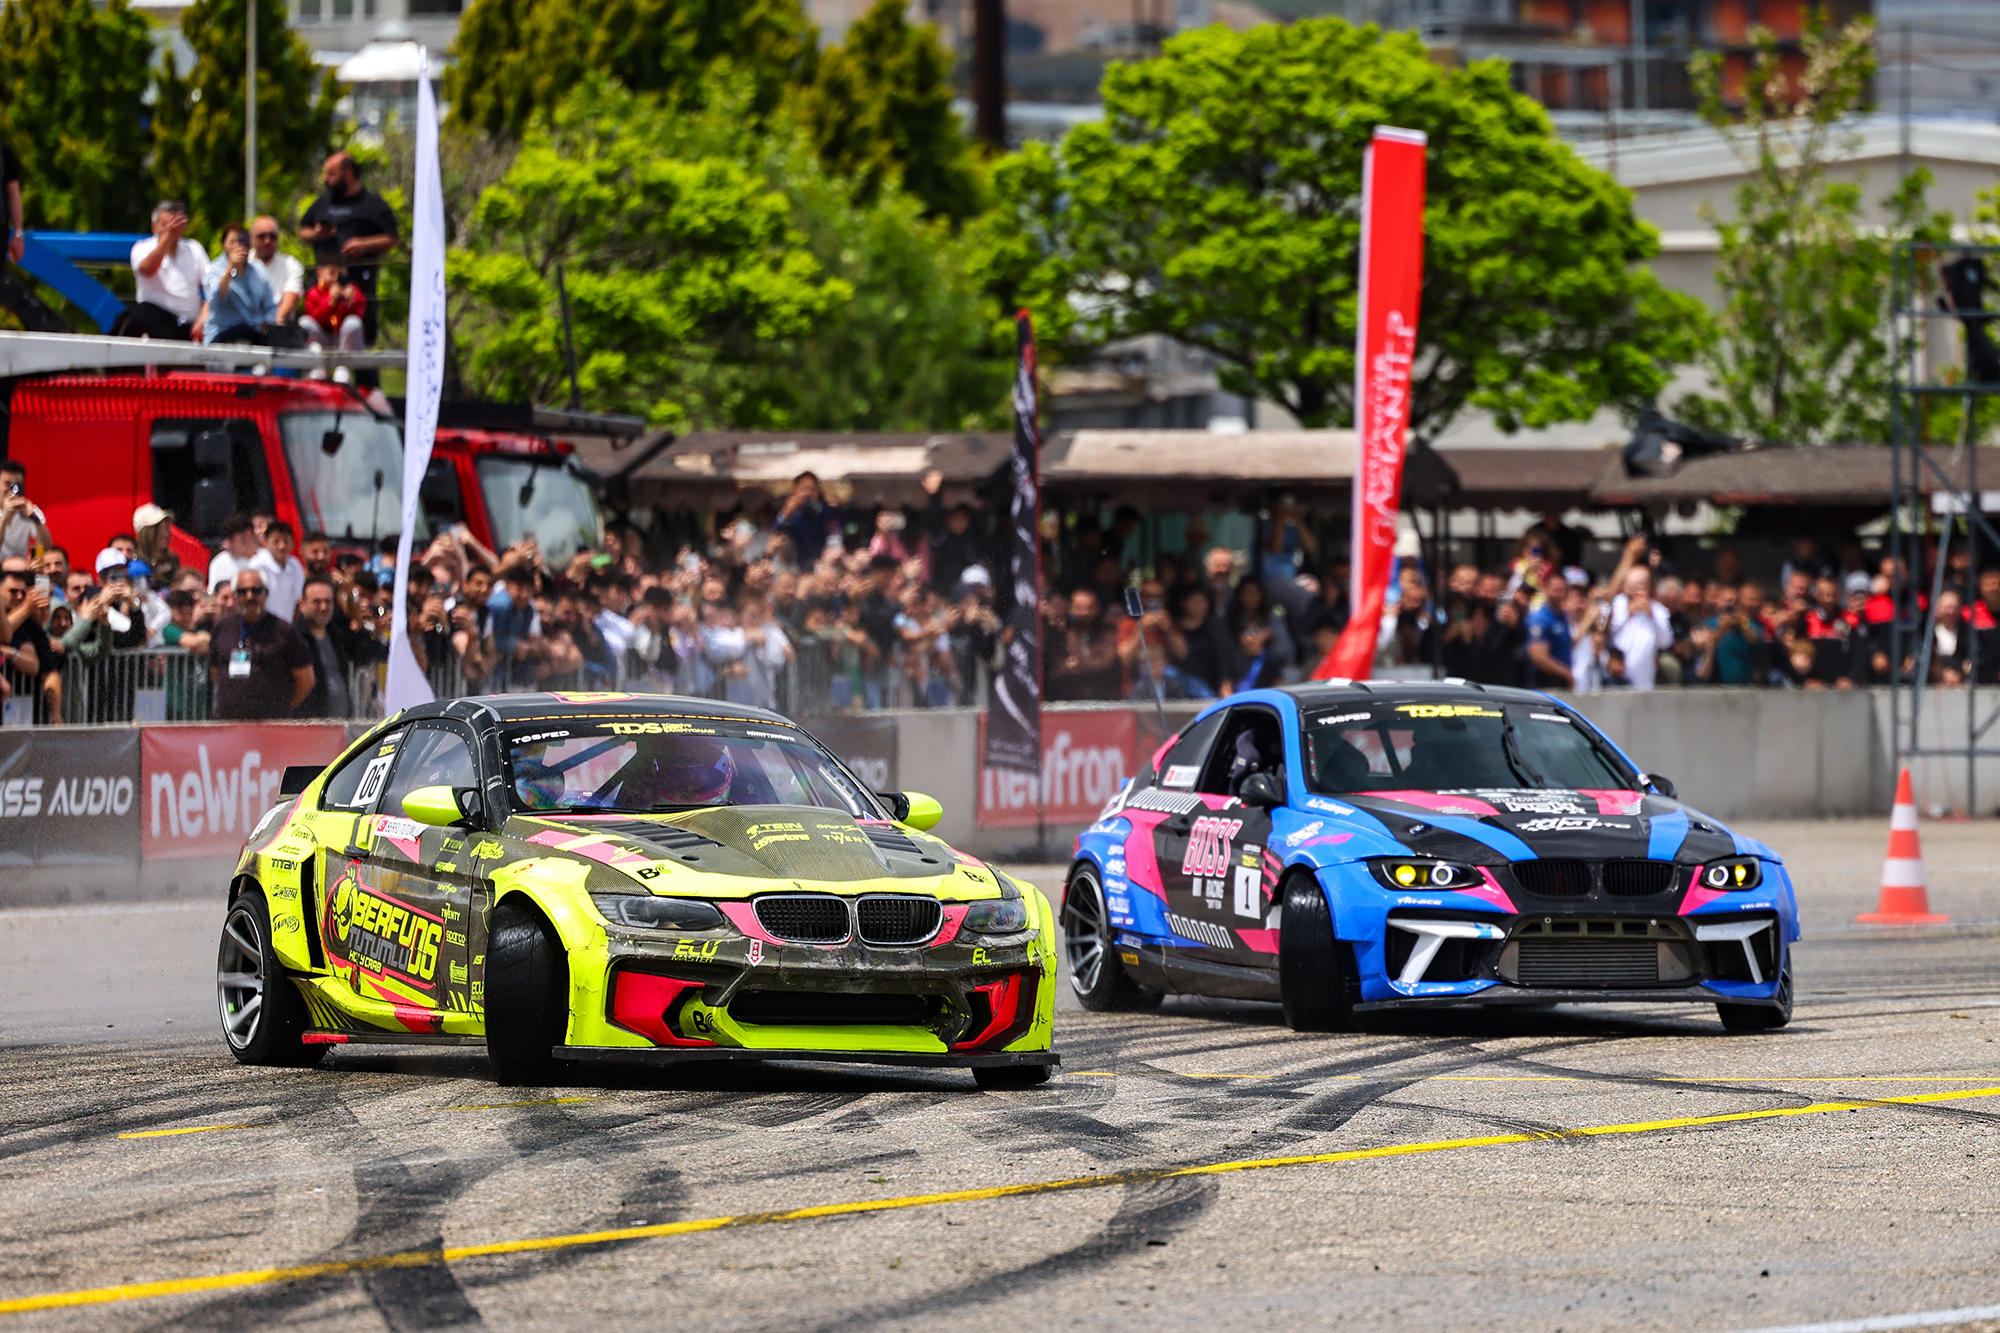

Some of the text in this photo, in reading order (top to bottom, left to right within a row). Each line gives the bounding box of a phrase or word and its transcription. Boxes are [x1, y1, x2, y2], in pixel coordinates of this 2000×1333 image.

[511, 730, 570, 744] TOSFED
[596, 721, 663, 735] TDS
[47, 775, 134, 817] AUDIO
[151, 744, 281, 838] newfr
[358, 762, 386, 801] 06
[1182, 816, 1243, 878] BOSS
[352, 891, 417, 949] BERFU
[348, 926, 410, 971] TUTUMLU
[671, 953, 715, 964] MASTER
[674, 940, 723, 957] ECU
